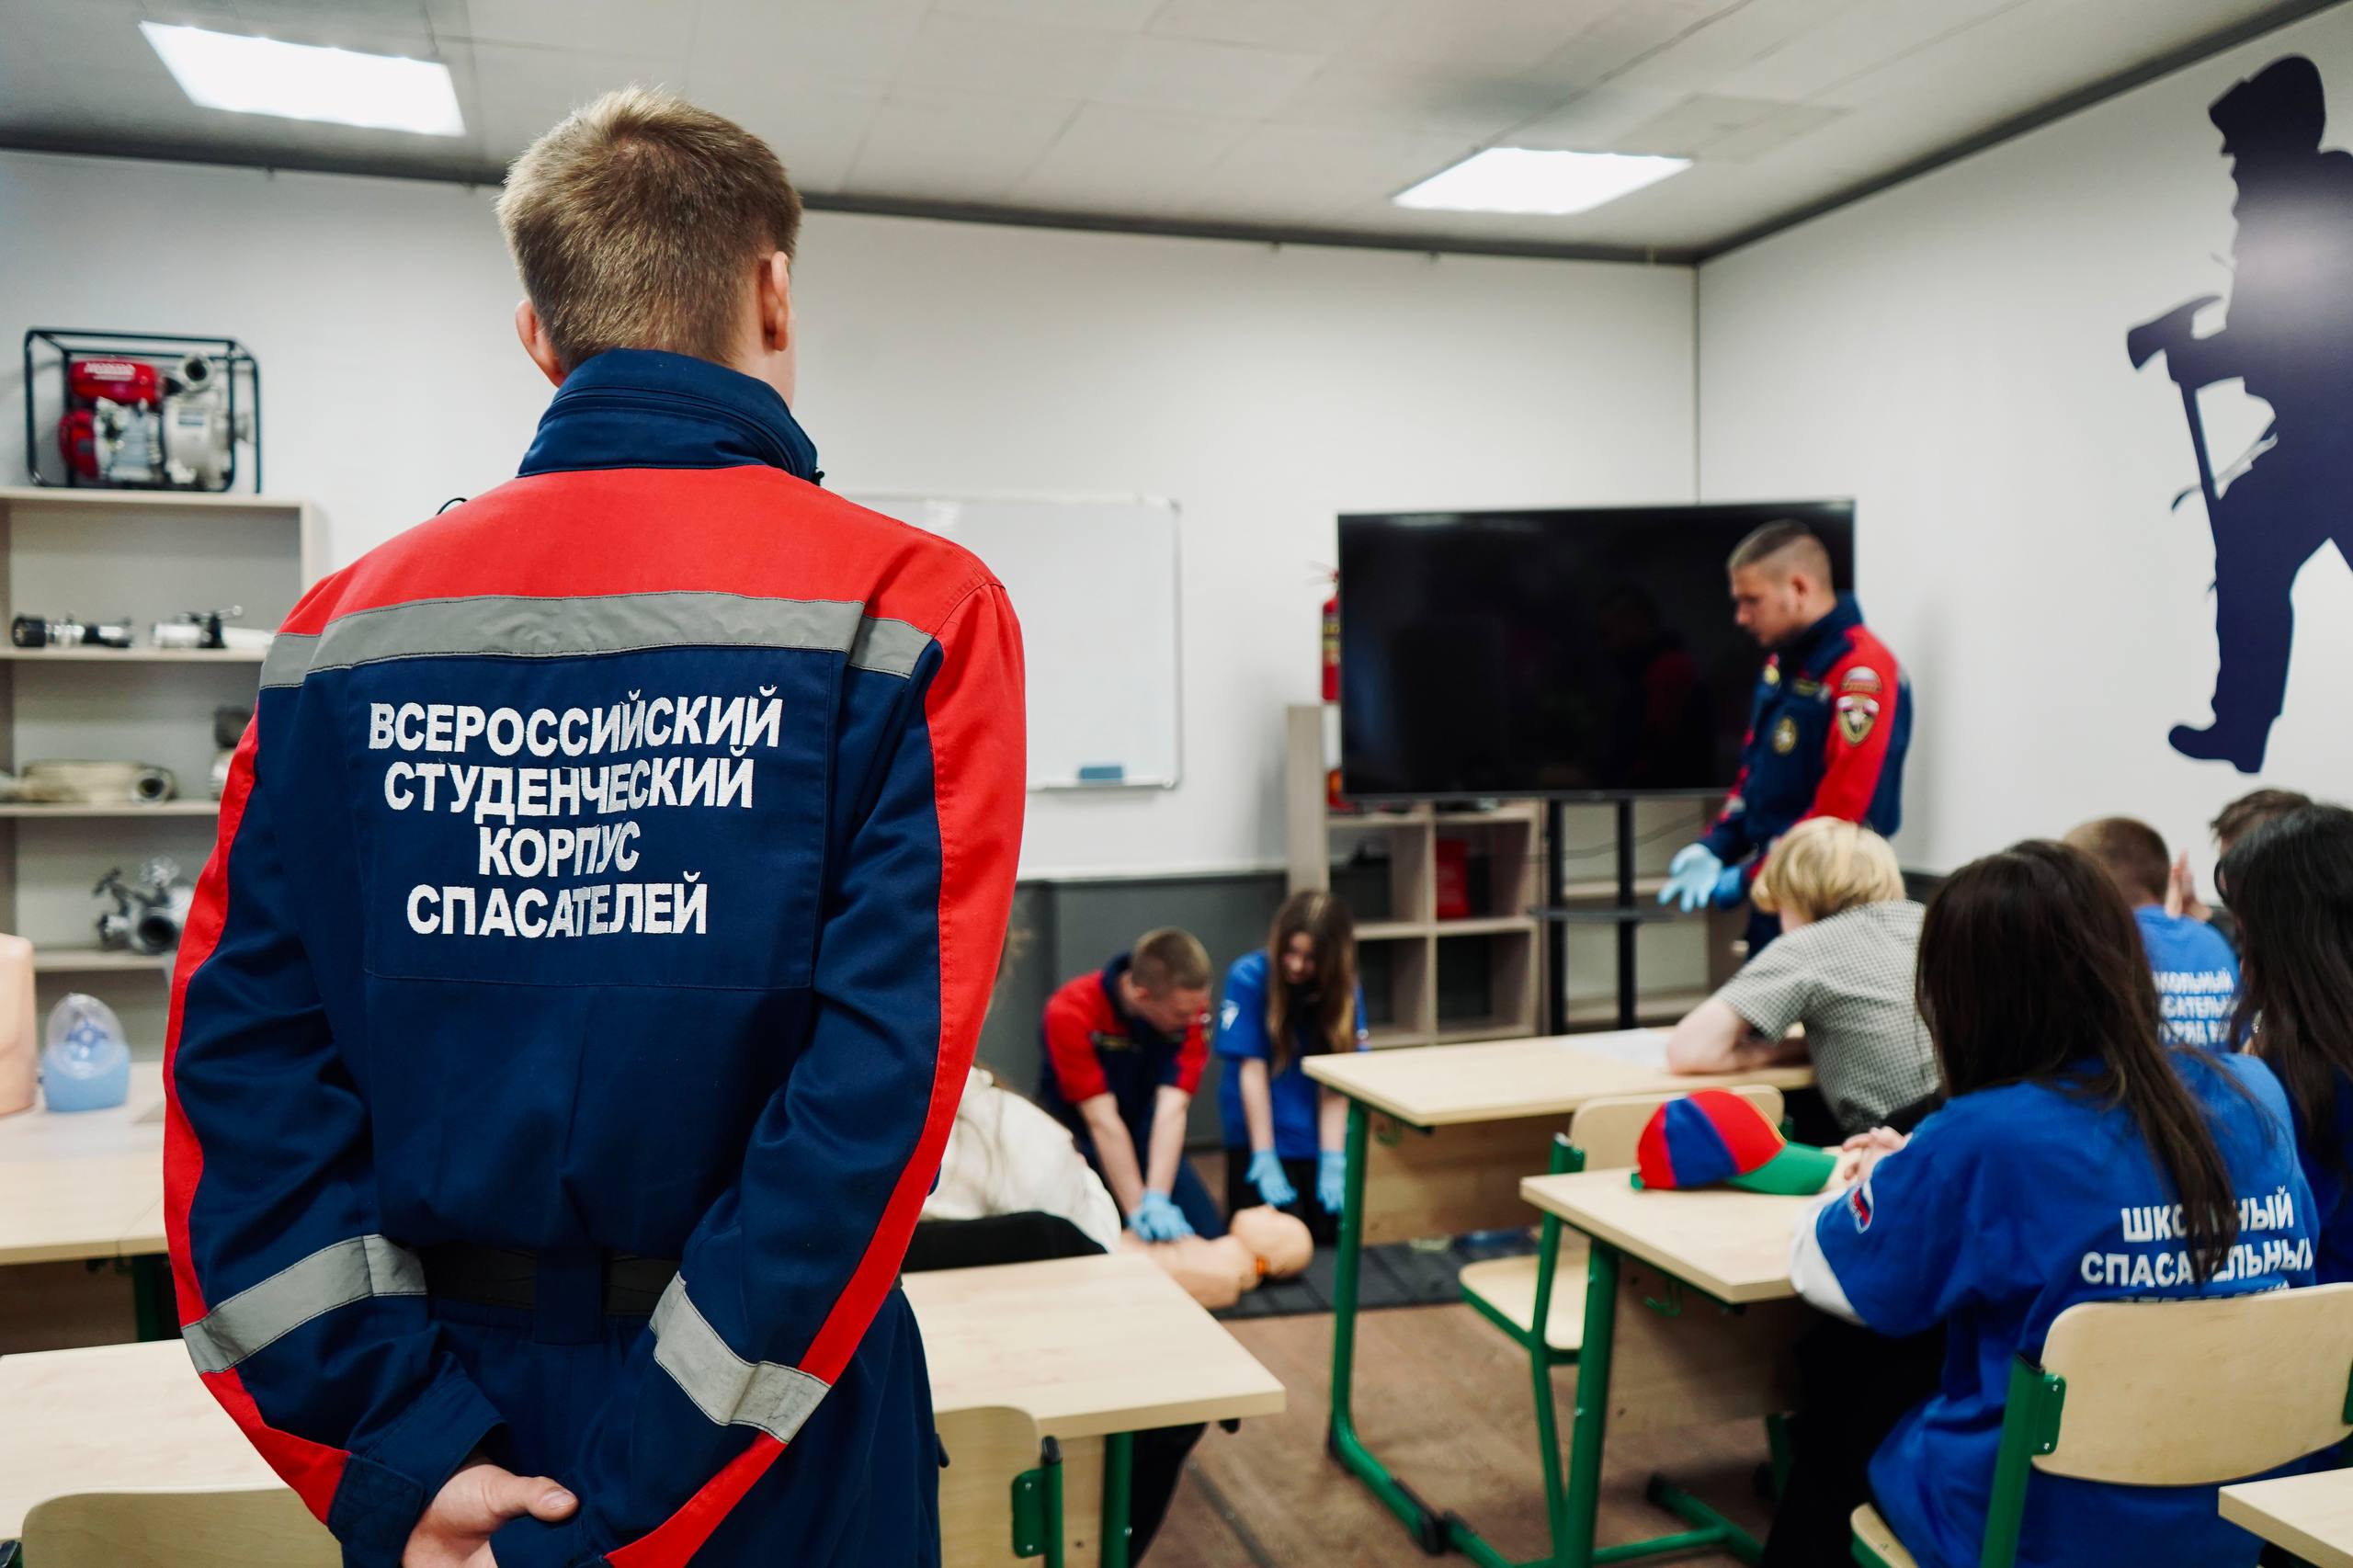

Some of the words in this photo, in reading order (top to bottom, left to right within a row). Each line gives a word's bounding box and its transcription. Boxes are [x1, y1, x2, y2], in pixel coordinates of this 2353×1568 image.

[369, 685, 783, 757] ВСЕРОССИЙСКИЙ
[384, 745, 755, 825] СТУДЕНЧЕСКИЙ
[478, 821, 642, 878] КОРПУС
[407, 871, 708, 938] СПАСАТЕЛЕЙ
